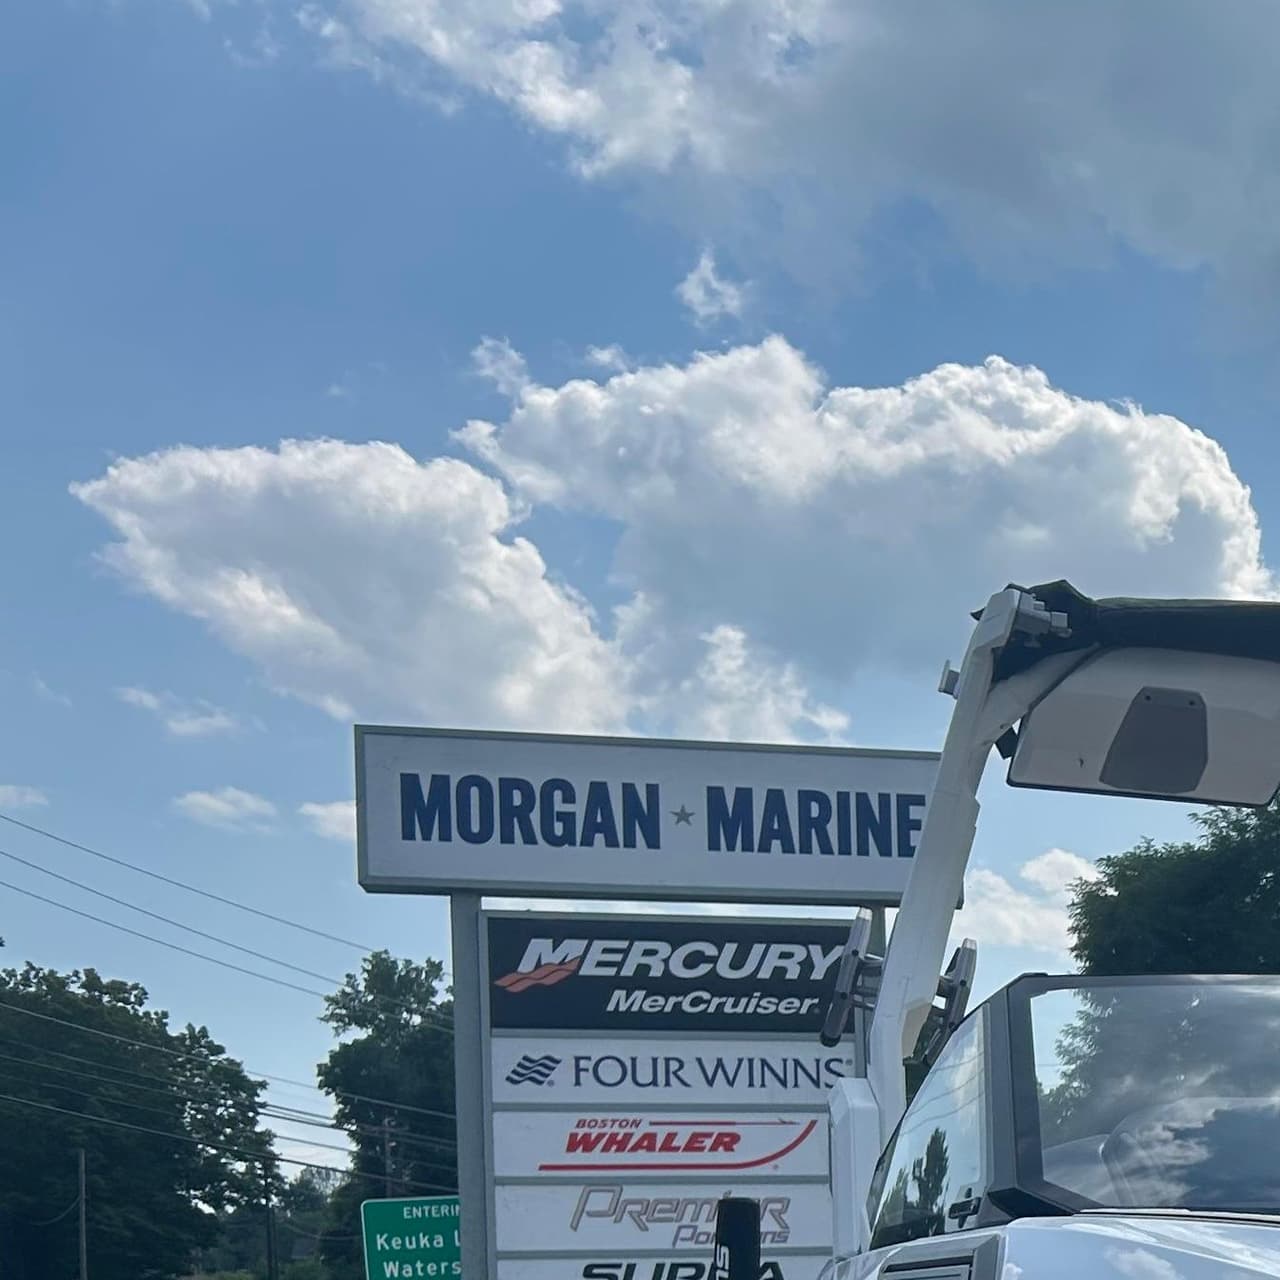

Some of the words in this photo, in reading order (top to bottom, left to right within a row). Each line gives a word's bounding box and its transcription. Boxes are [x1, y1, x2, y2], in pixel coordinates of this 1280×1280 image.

[400, 773, 661, 849] MORGAN
[706, 786, 926, 858] MARINE
[517, 938, 845, 980] MERCURY
[605, 989, 819, 1015] MerCruiser
[573, 1055, 692, 1088] FOUR
[696, 1057, 847, 1089] WINNS
[575, 1118, 643, 1129] BOSTON
[565, 1132, 742, 1153] WHALER
[376, 1231, 444, 1251] Keuka
